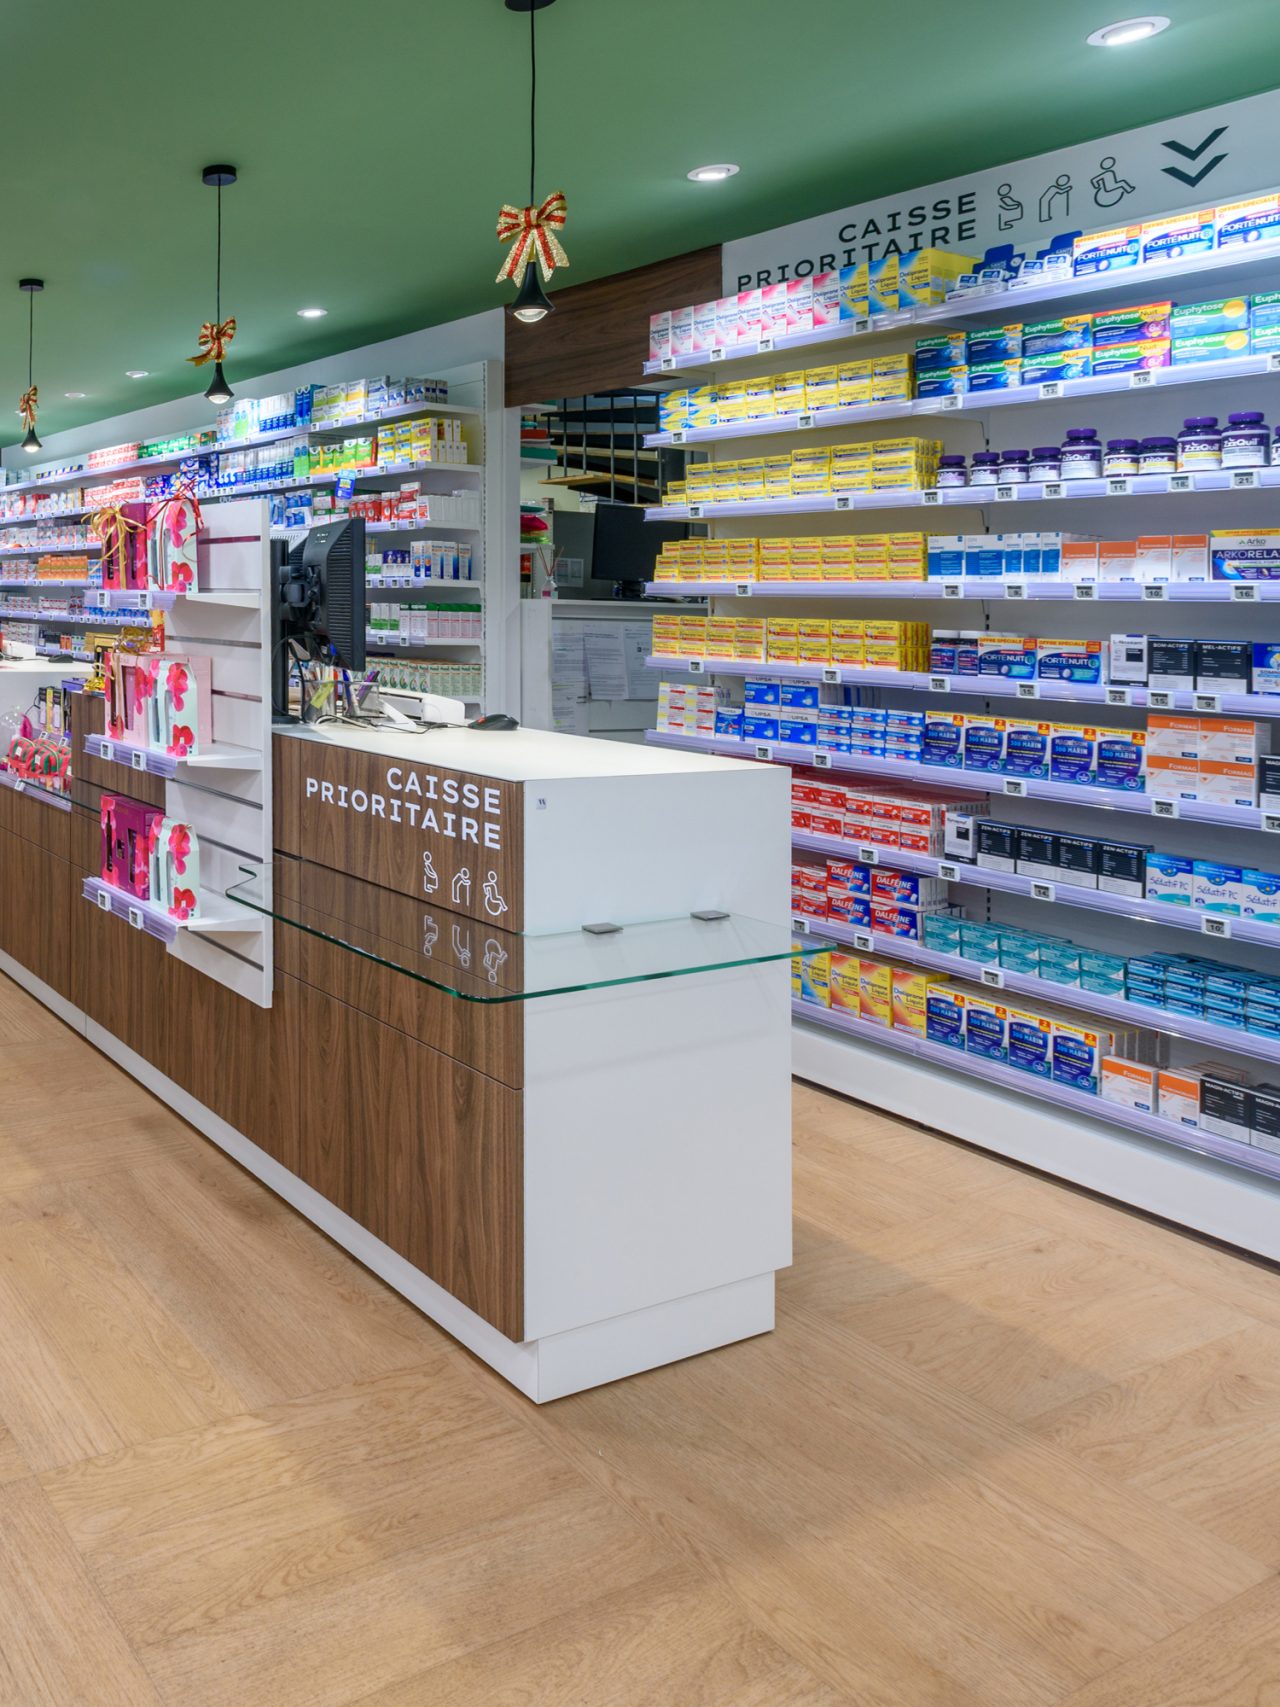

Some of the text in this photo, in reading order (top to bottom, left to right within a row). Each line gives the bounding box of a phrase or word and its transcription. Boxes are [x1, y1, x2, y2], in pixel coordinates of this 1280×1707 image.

[839, 192, 976, 243] CAISSE
[737, 219, 976, 292] PRIORITAIRE
[1173, 302, 1224, 317] Euphytose
[1095, 312, 1139, 325] Euphytose
[1025, 321, 1062, 333] Euphytose
[1175, 334, 1225, 347] Euphytose
[1184, 442, 1220, 452] ZzzQuil
[1223, 437, 1258, 448] ZzzQuil
[1247, 538, 1267, 546] Arko
[1216, 549, 1280, 559] ARKORELA
[387, 767, 501, 815] CAISSE
[306, 777, 501, 850] PRIORITAIRE
[831, 866, 865, 880] DALFÉINE
[877, 875, 912, 889] DALFÉINE
[831, 898, 865, 912] DALFÉINE
[875, 909, 911, 924] DALFÉINE
